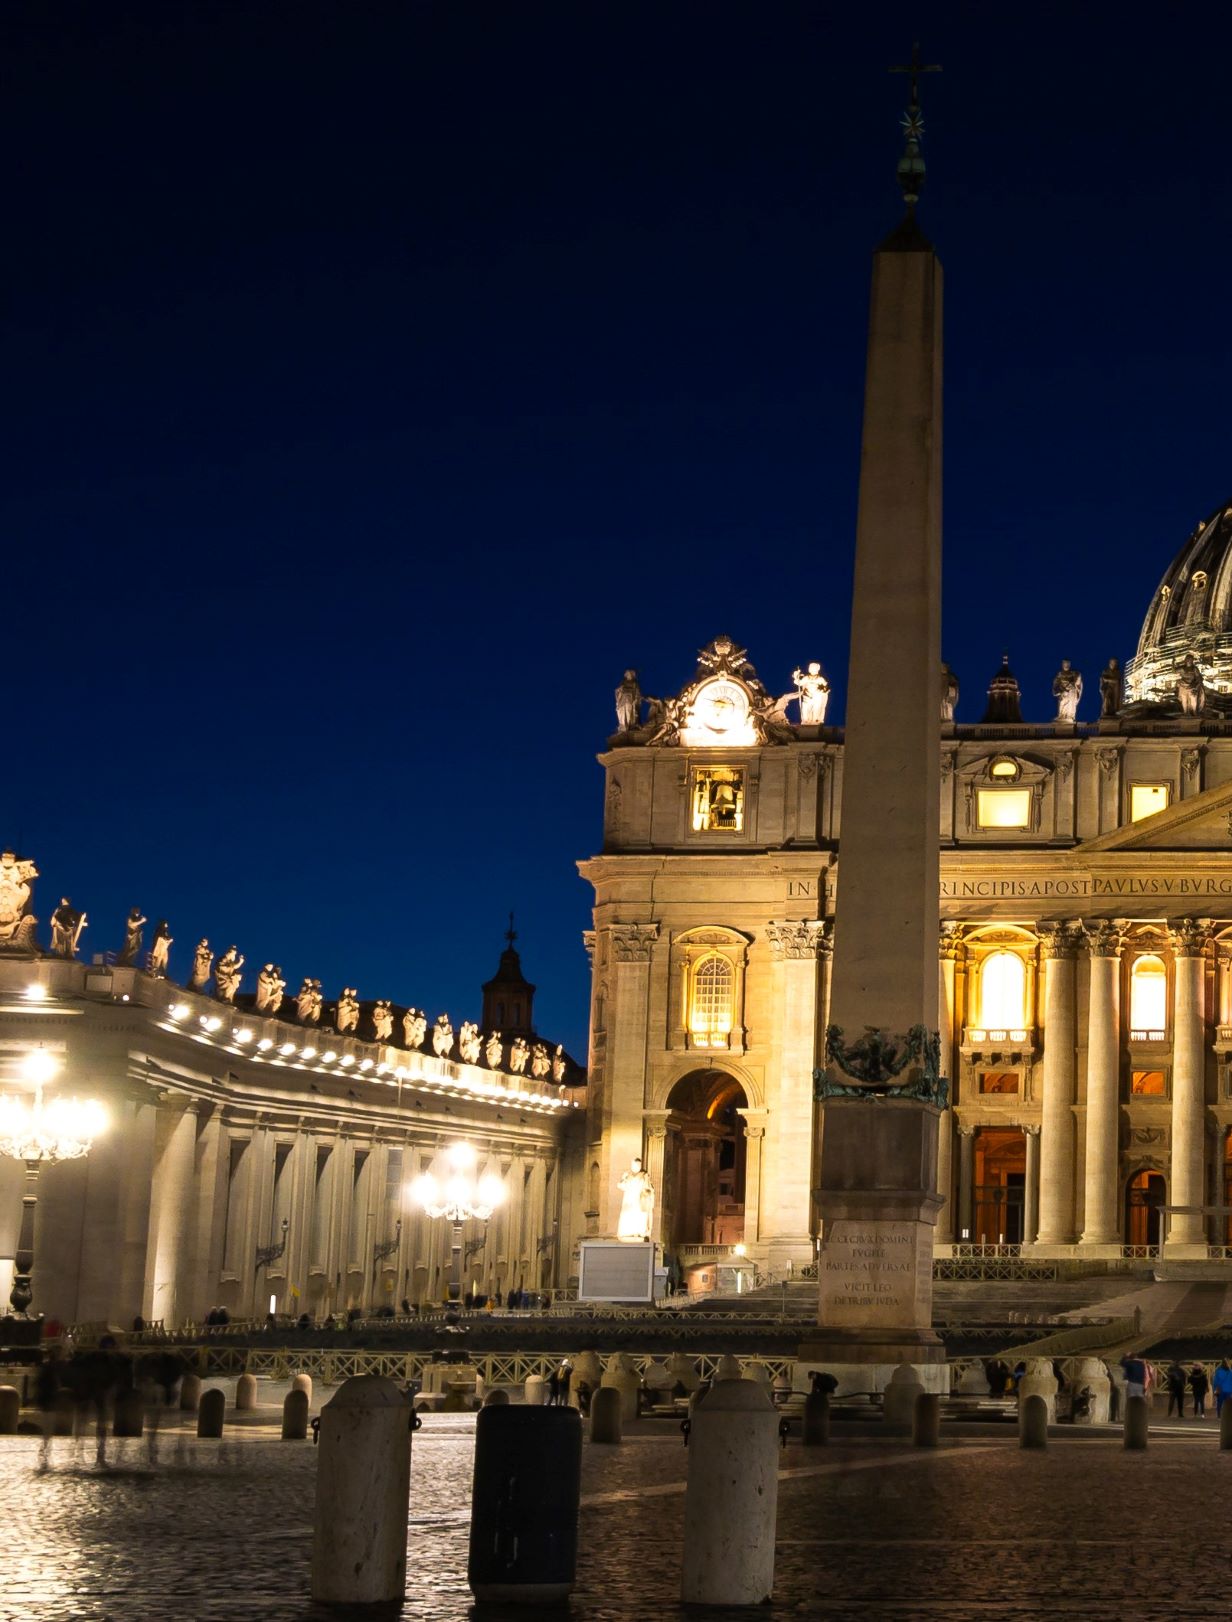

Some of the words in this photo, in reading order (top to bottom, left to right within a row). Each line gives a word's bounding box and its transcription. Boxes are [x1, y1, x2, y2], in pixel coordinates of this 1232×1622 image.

[789, 881, 810, 896] IN
[939, 880, 1025, 896] RINCIPIS
[1030, 880, 1091, 895] APOST
[1093, 878, 1159, 893] PAVLVS
[1163, 878, 1174, 893] V
